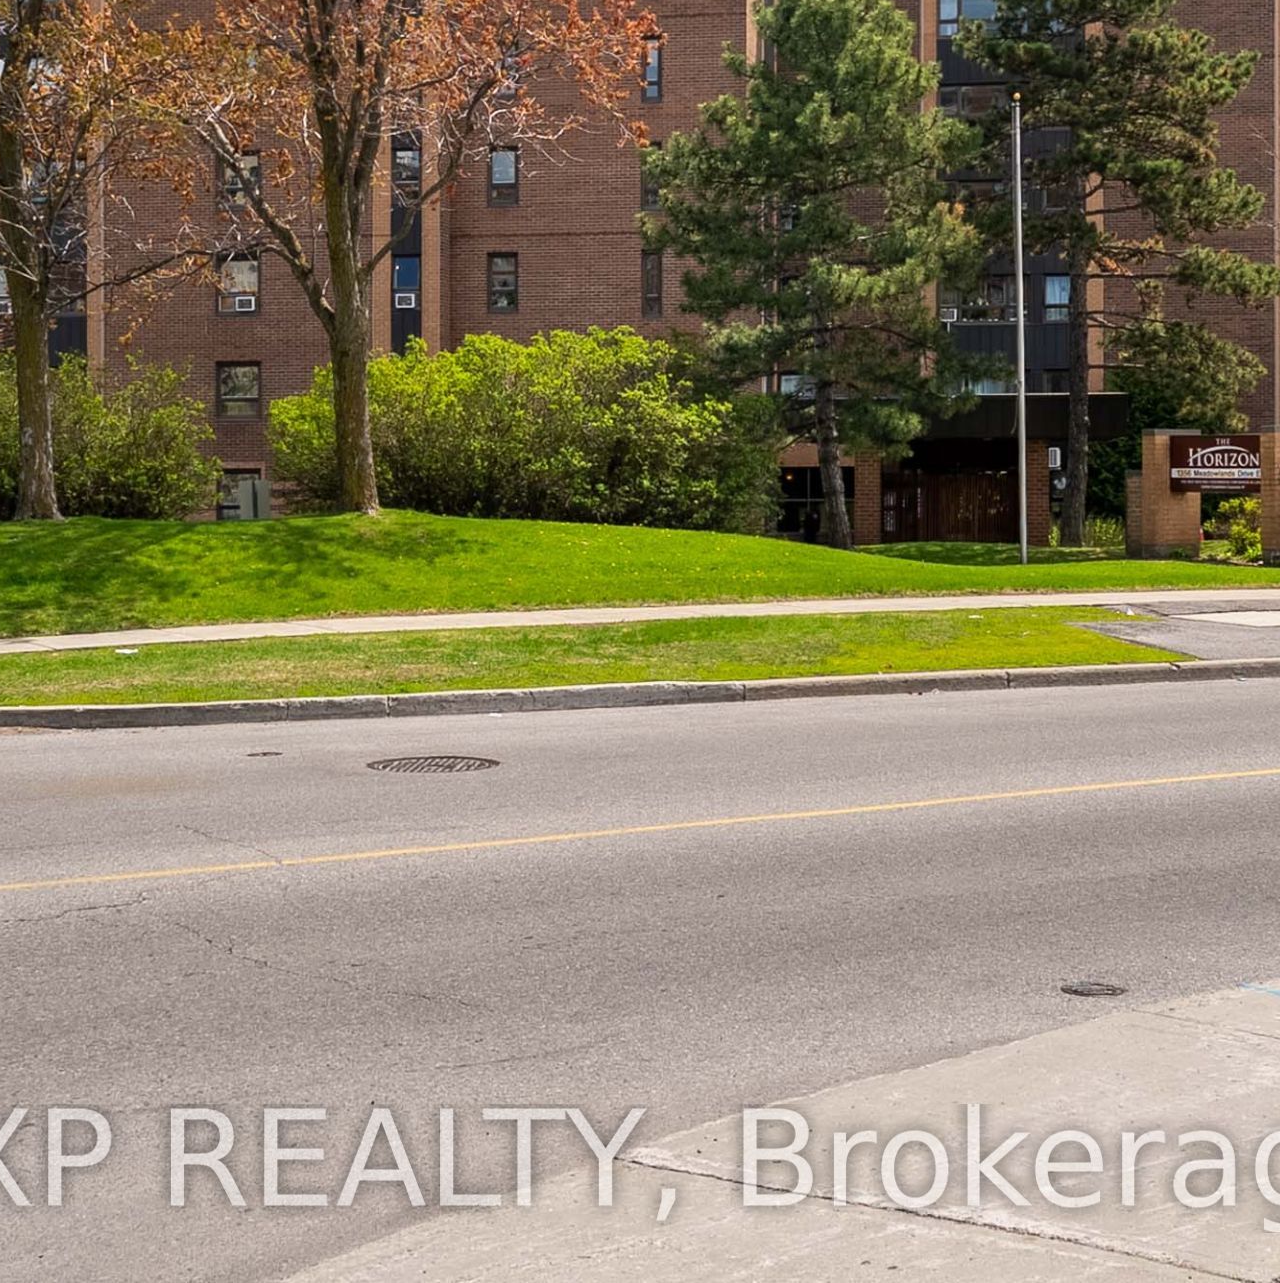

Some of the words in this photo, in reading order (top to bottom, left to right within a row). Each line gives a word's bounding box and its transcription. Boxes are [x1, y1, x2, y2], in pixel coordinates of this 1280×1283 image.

[1215, 438, 1231, 446] THE
[1187, 447, 1260, 467] HORIZON
[1193, 469, 1235, 477] Meadowlands
[1237, 469, 1254, 477] Drive
